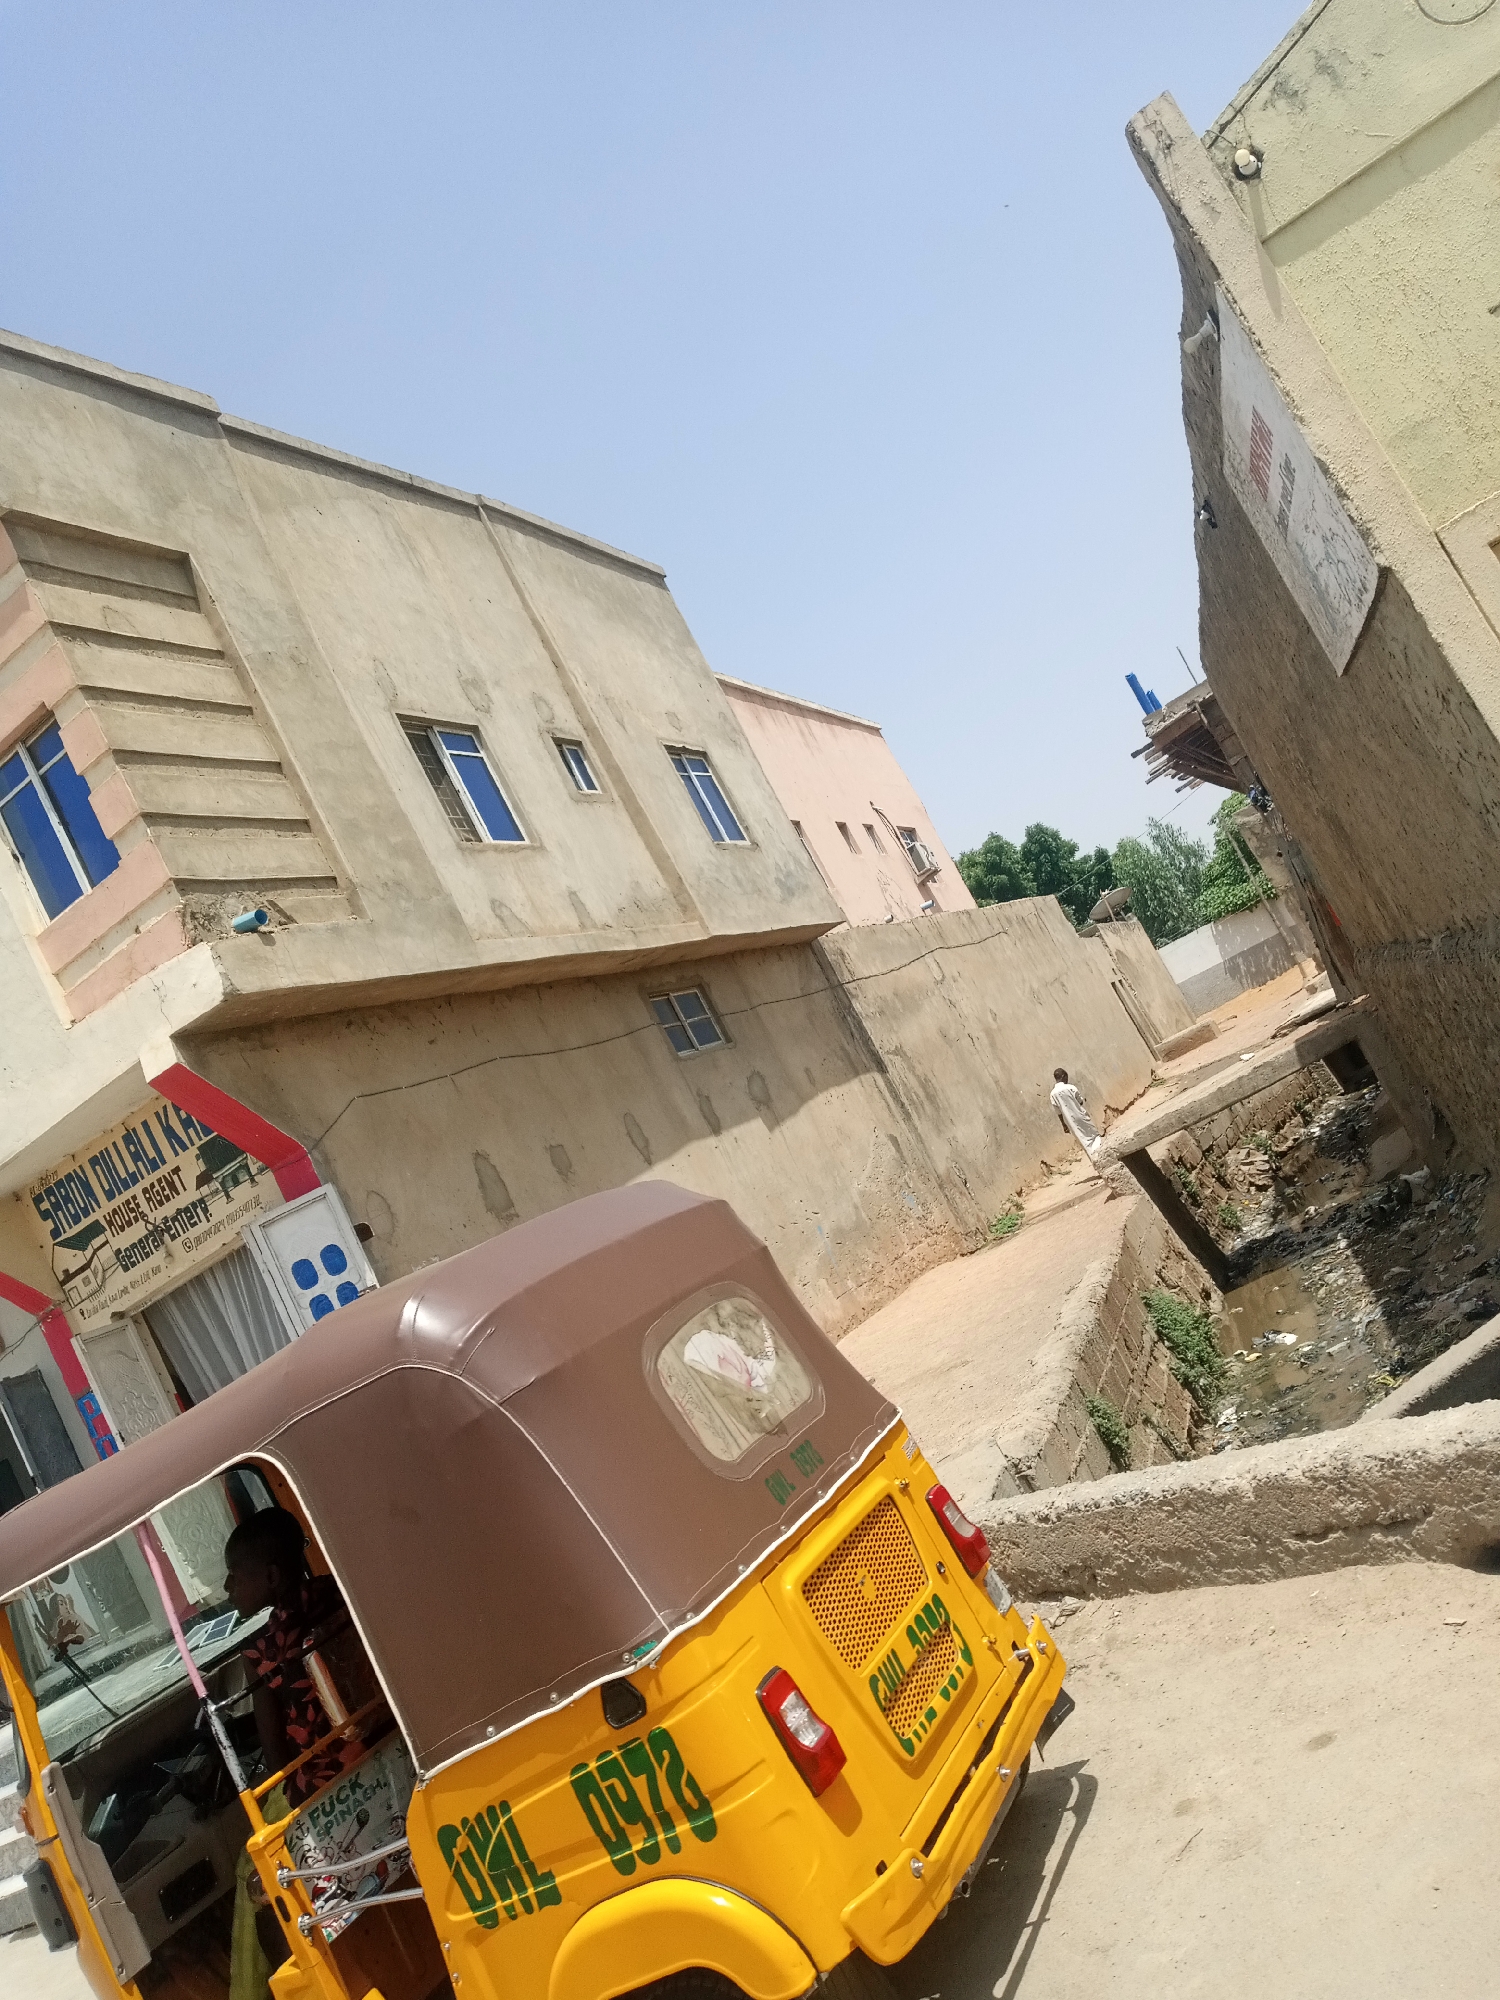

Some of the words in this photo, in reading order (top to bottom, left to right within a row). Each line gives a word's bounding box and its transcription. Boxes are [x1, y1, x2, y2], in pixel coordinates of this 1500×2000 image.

[34, 1166, 100, 1239] SABON
[91, 1119, 167, 1201] DILLALI
[103, 1195, 144, 1236] HOUSE
[141, 1165, 190, 1211] AGENT
[310, 1772, 365, 1828] FUCK
[437, 1800, 562, 1929] GWL
[571, 1727, 717, 1875] 0972
